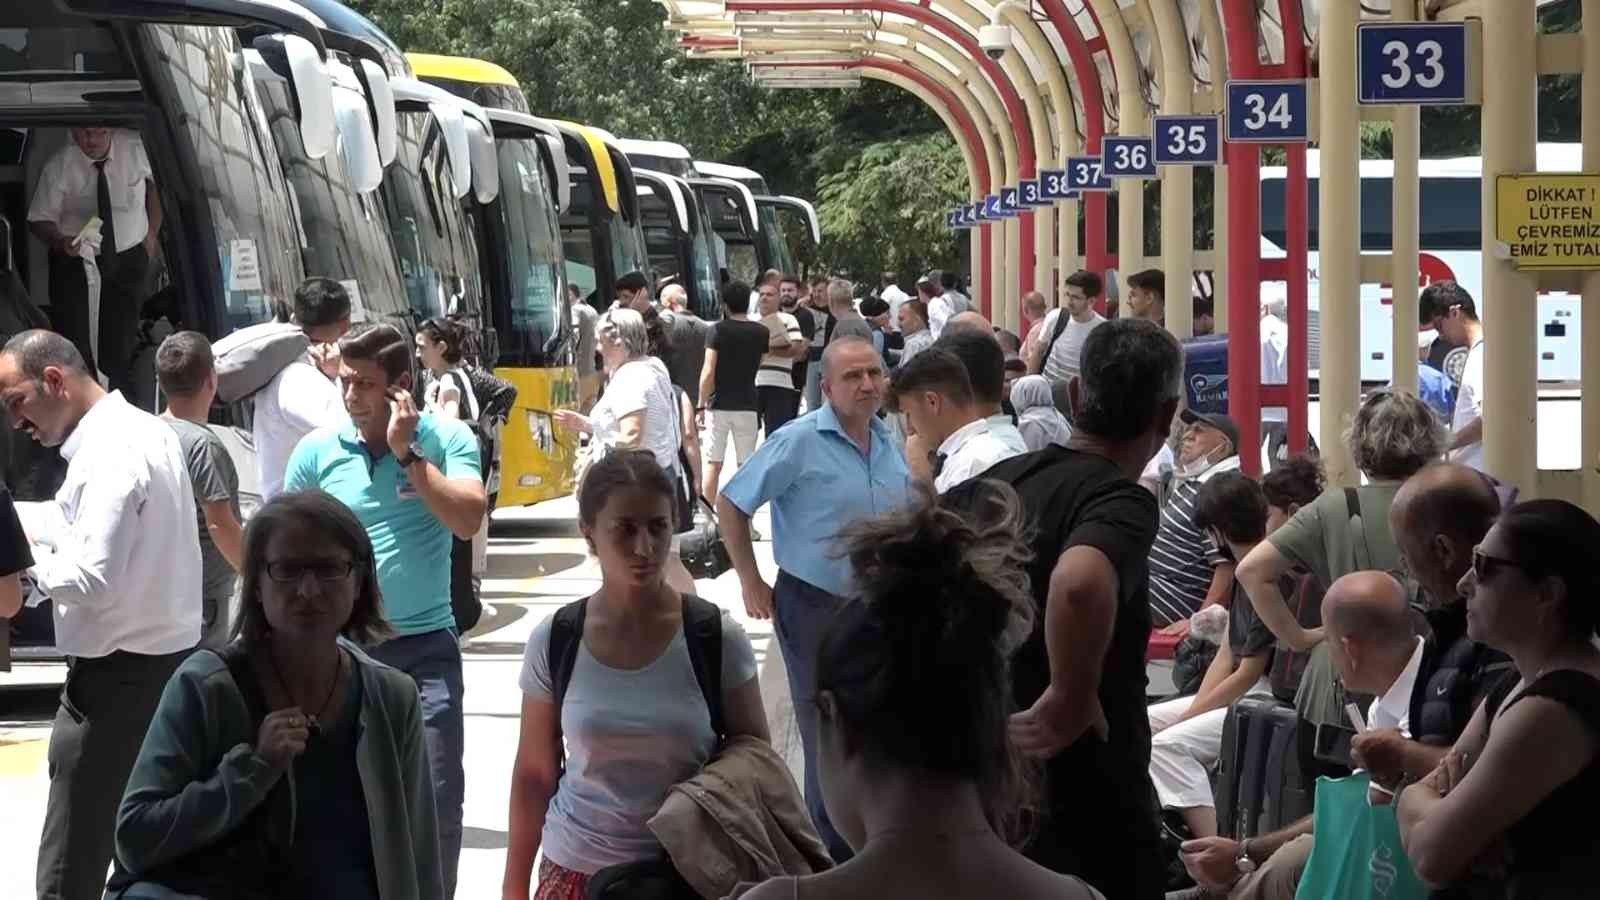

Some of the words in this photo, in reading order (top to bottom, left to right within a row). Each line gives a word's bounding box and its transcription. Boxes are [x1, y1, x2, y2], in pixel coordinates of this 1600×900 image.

[1381, 40, 1445, 88] 33
[1243, 92, 1292, 131] 34
[1167, 125, 1207, 155] 35
[1113, 144, 1147, 170] 36
[1076, 163, 1102, 185] 37
[1526, 185, 1586, 202] DİKKAT
[1529, 203, 1593, 220] LÜTFEN
[1509, 240, 1548, 257] EMİZ
